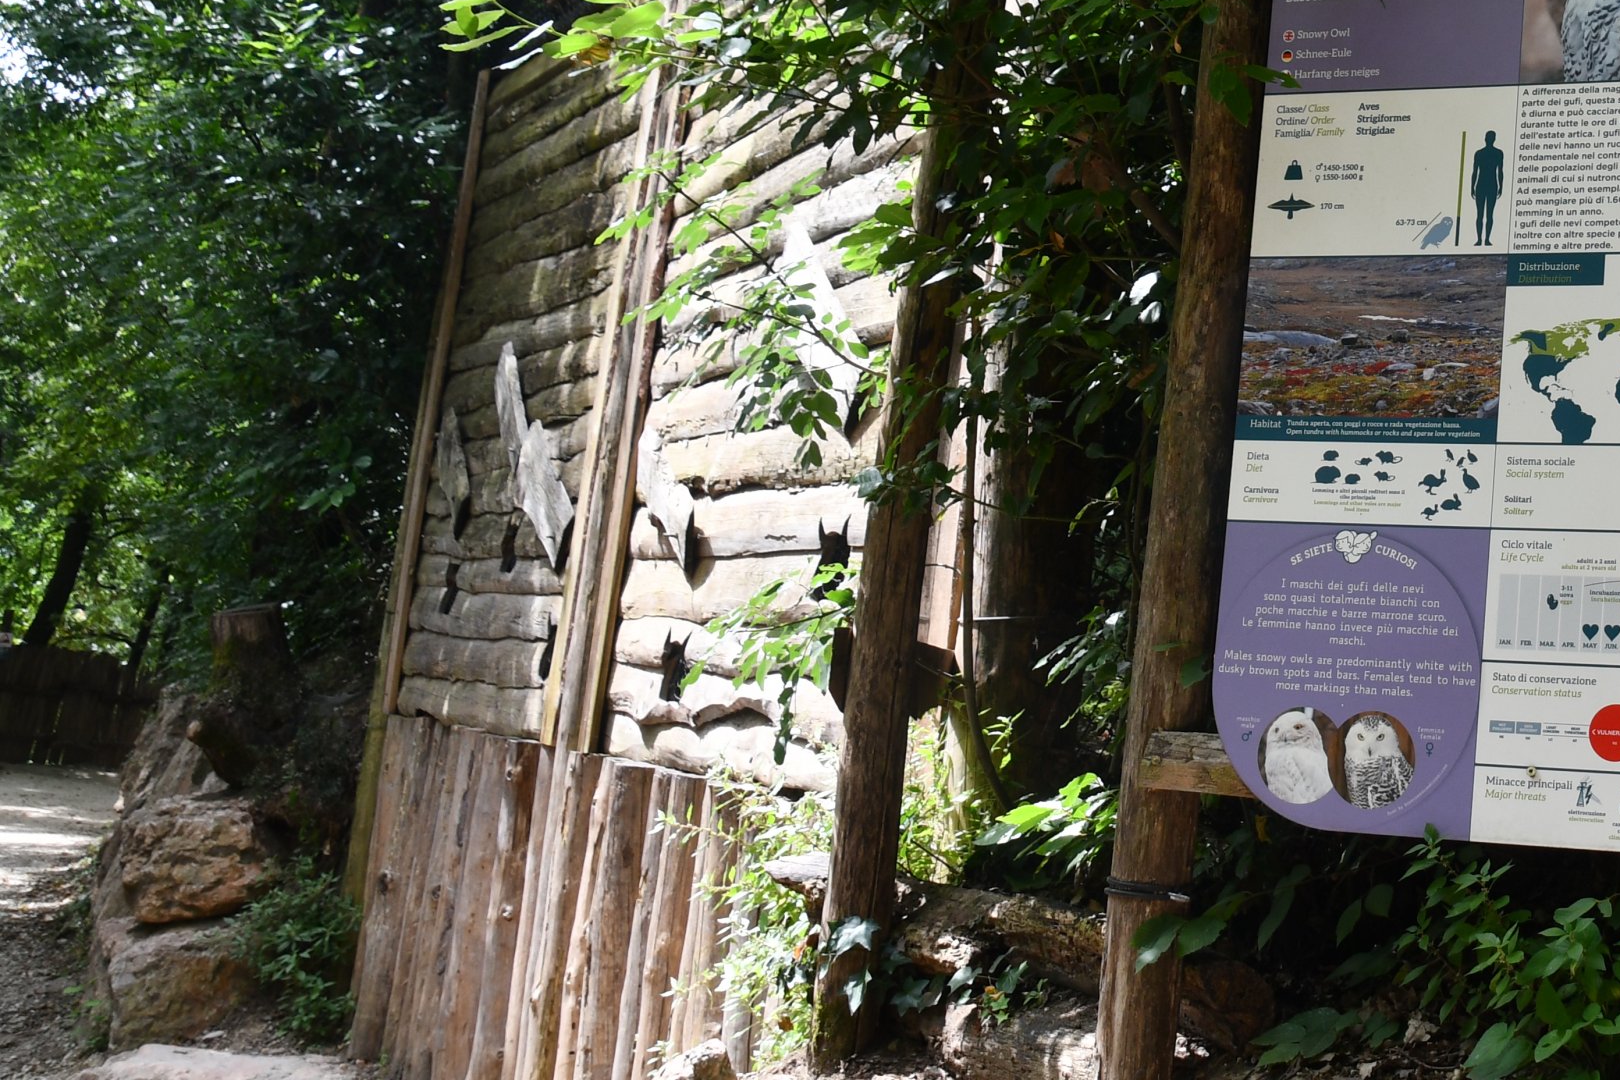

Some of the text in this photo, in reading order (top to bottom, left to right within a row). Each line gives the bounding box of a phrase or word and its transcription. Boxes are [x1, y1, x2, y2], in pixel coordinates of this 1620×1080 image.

[1297, 28, 1350, 40] Snowy Owl
[1296, 49, 1352, 59] Schnee-Eule
[1294, 67, 1380, 80] Harfang des neiges
[1532, 87, 1576, 95] differenza
[1358, 102, 1379, 111] Aves
[1522, 99, 1545, 108] parte
[1564, 97, 1583, 106] gufi,
[1586, 97, 1615, 105] questa
[1277, 105, 1306, 113] Classe/
[1521, 109, 1526, 117] è
[1529, 109, 1557, 117] diurna
[1567, 108, 1584, 117] può
[1276, 116, 1335, 125] Ordine/ Order
[1357, 113, 1411, 124] Strigiformes
[1275, 127, 1344, 138] Famiglia/ Family
[1356, 126, 1395, 136] Strigidae
[1520, 262, 1580, 272] Distribuzione
[1250, 419, 1281, 428] Habitat
[1345, 421, 1361, 429] poggi
[1247, 451, 1269, 460] Dieta
[1507, 457, 1575, 466] Sistema sociale
[1246, 463, 1263, 472] Diet
[1506, 469, 1564, 480] Social system
[1244, 486, 1279, 494] Carnivora
[1243, 496, 1278, 504] Carnivore
[1504, 507, 1534, 516] Solitary
[1501, 540, 1552, 550] Ciclo vitale
[1290, 542, 1418, 570] SE SIETE CURIOSI
[1501, 552, 1544, 564] Life Cycle
[1281, 578, 1424, 594] I maschi dei gufi delle nevi
[1264, 594, 1440, 608] sono quasi totalmente bianchi con
[1255, 605, 1447, 622] poche macchie e barre marrone scuro.
[1242, 618, 1459, 636] Le femmine hanno invece più macchie dei
[1329, 635, 1366, 646] maschi.
[1224, 650, 1472, 672] Males snowy owls are predominantly white with
[1492, 672, 1597, 686] Stato di conservazione
[1492, 685, 1582, 698] Conservation status
[1486, 776, 1573, 791] Minacce principali
[1485, 788, 1546, 802] Major threats
